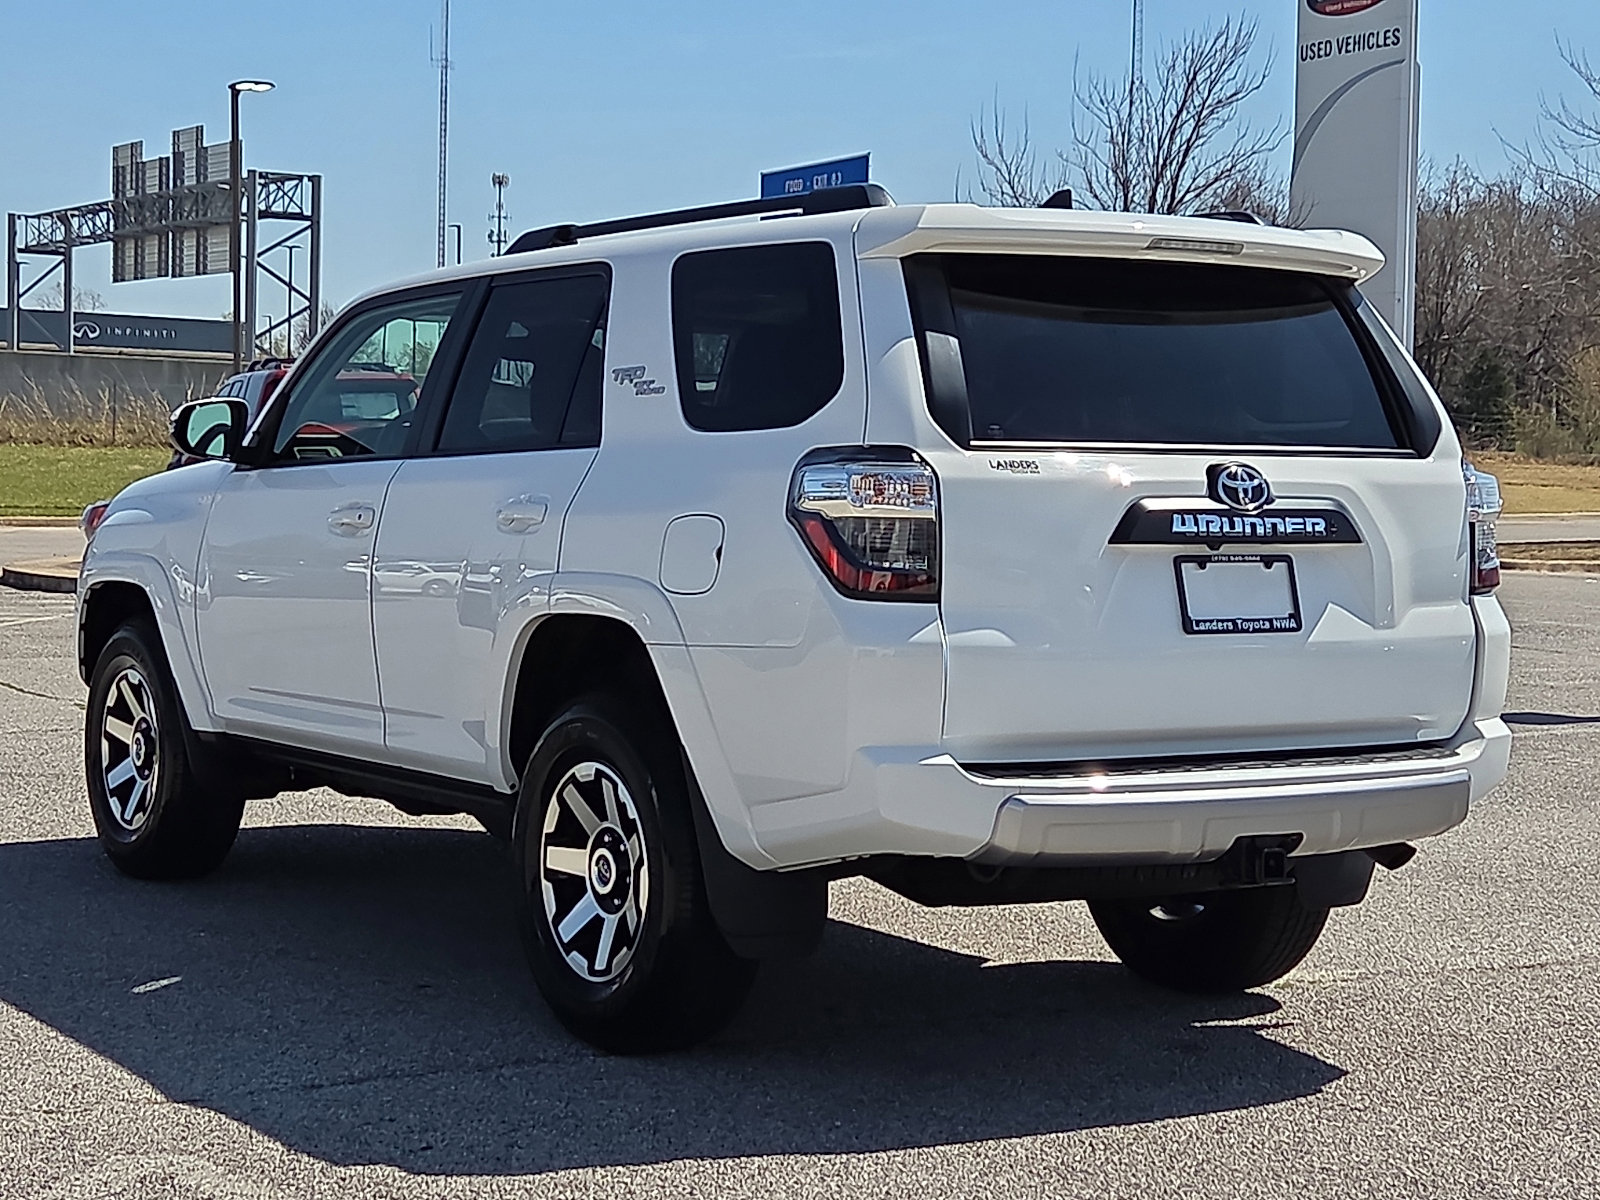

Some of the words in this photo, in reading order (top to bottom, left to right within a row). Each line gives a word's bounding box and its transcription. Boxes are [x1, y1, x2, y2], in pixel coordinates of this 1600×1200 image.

[1300, 39, 1332, 62] USED
[1336, 27, 1401, 55] VEHICLES
[106, 326, 177, 339] INFINITI
[612, 366, 646, 385] TRD
[988, 459, 1039, 470] LANDERS
[1172, 513, 1327, 536] 4RUNNER
[1193, 619, 1234, 631] Landers
[1235, 619, 1271, 632] Toyota
[1272, 618, 1298, 629] NWA
